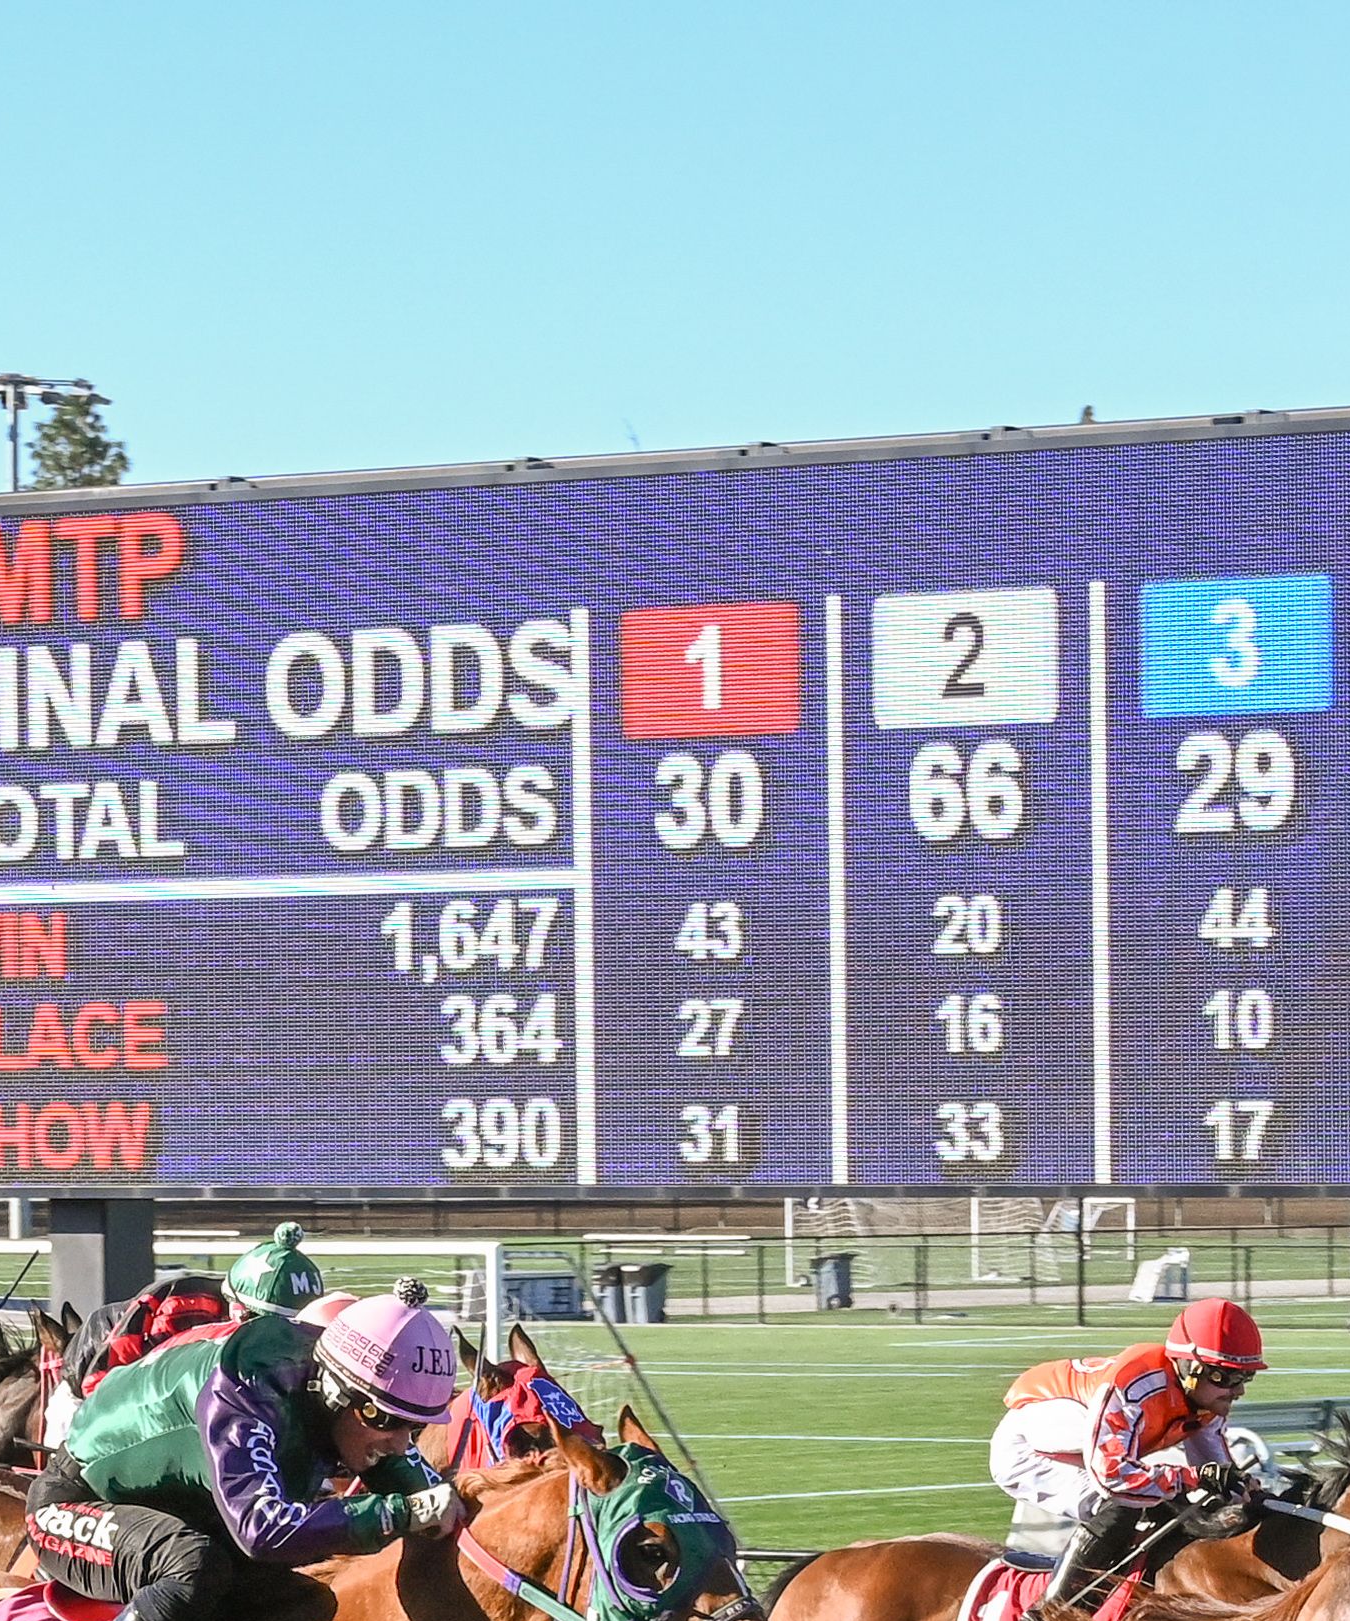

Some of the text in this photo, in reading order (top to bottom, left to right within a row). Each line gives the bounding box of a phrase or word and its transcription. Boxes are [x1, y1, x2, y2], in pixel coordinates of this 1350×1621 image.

[266, 619, 575, 738] ODDS
[685, 626, 722, 710] 1
[941, 613, 985, 699] 2
[1209, 599, 1261, 687] 3
[320, 766, 558, 851] ODDS
[653, 751, 764, 849] 30
[909, 741, 1025, 841] 66
[1175, 729, 1297, 833] 29
[381, 899, 559, 982] 1,647
[673, 902, 744, 959] 43
[933, 896, 1003, 954] 20
[1197, 888, 1277, 948] 44
[440, 995, 562, 1066] 364
[676, 999, 744, 1057] 27
[936, 996, 1003, 1053] 16
[1201, 991, 1272, 1049] 10
[442, 1098, 561, 1167] 390
[678, 1106, 741, 1162] 31
[934, 1105, 1005, 1160] 33
[1201, 1102, 1273, 1159] 17
